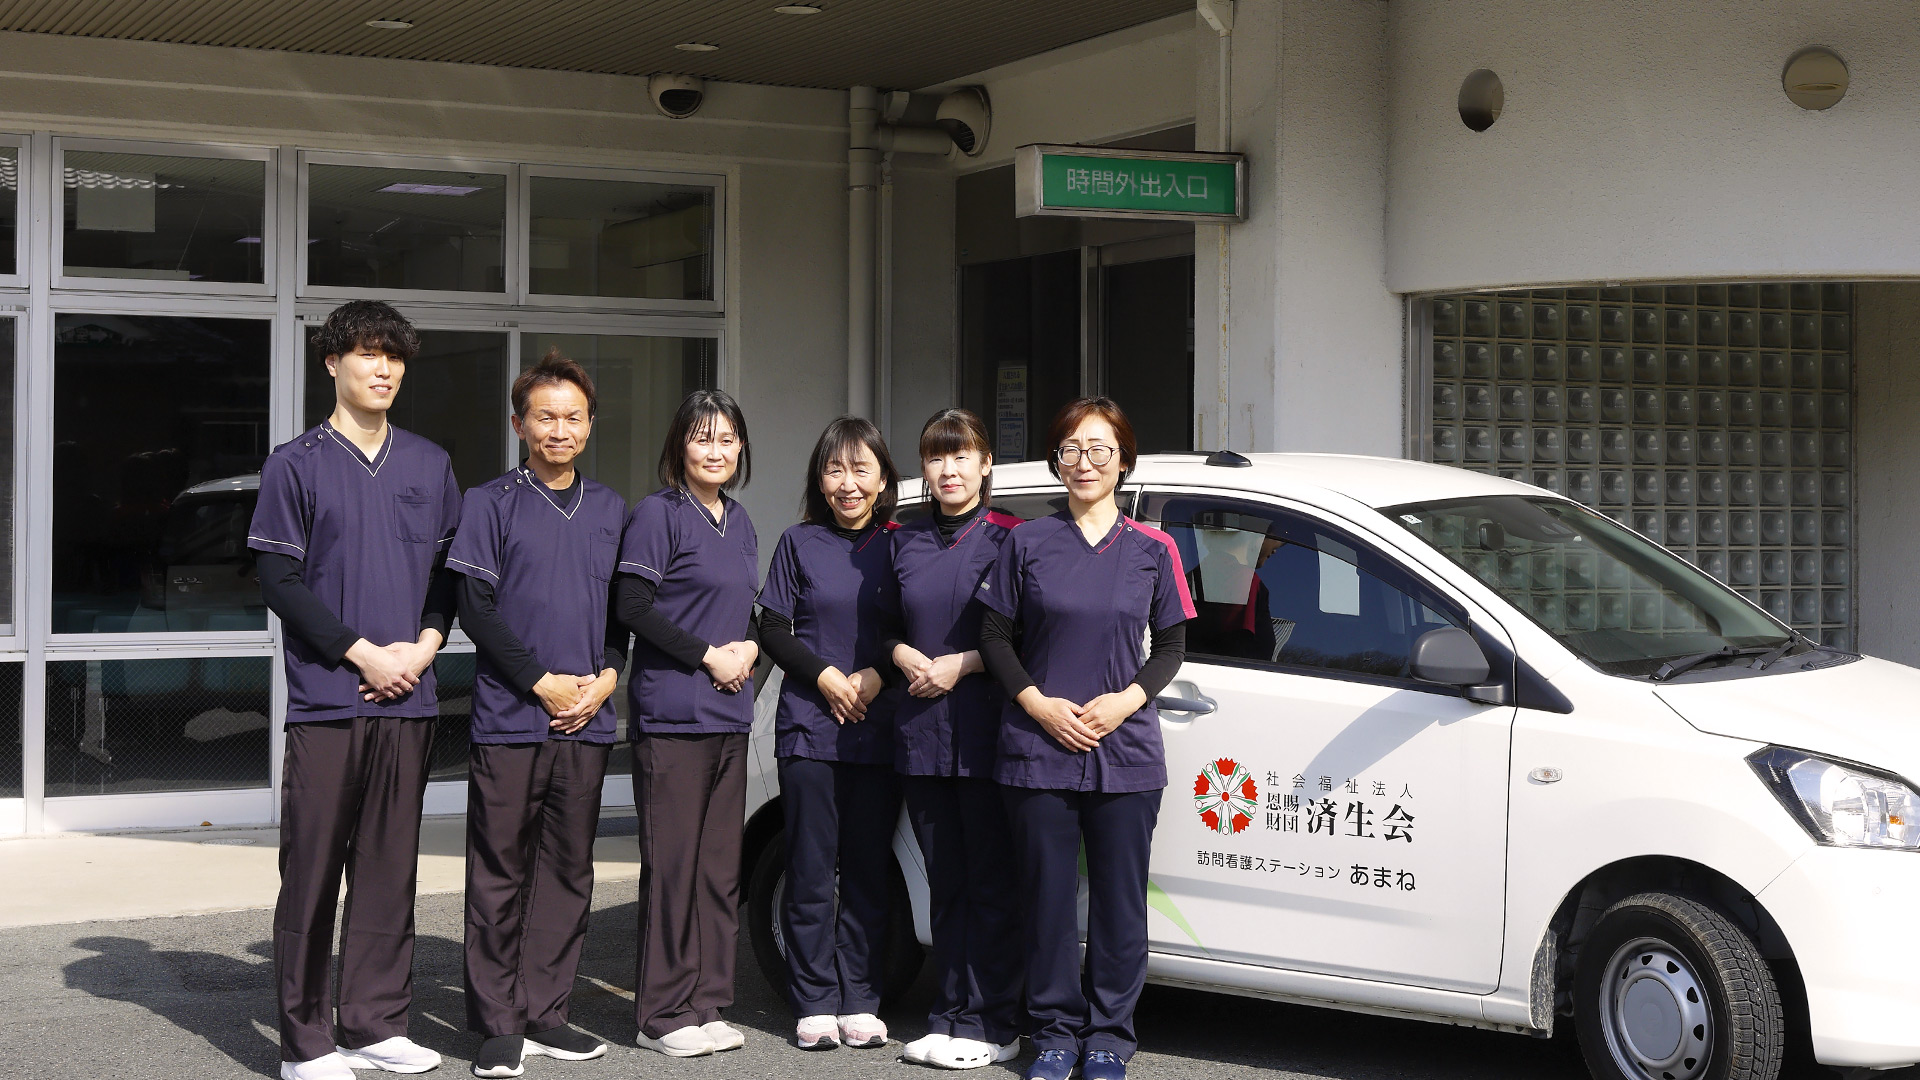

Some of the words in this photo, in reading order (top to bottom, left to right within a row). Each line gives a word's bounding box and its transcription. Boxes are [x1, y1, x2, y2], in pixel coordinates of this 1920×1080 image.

[1067, 168, 1207, 199] 時間外出入口
[1266, 771, 1413, 799] 社会福祉法人
[1266, 792, 1299, 813] 恩賜
[1266, 812, 1299, 834] 財団
[1306, 798, 1416, 843] 済生会
[1197, 850, 1341, 879] 訪問看護ステーション
[1350, 864, 1416, 891] あまね
